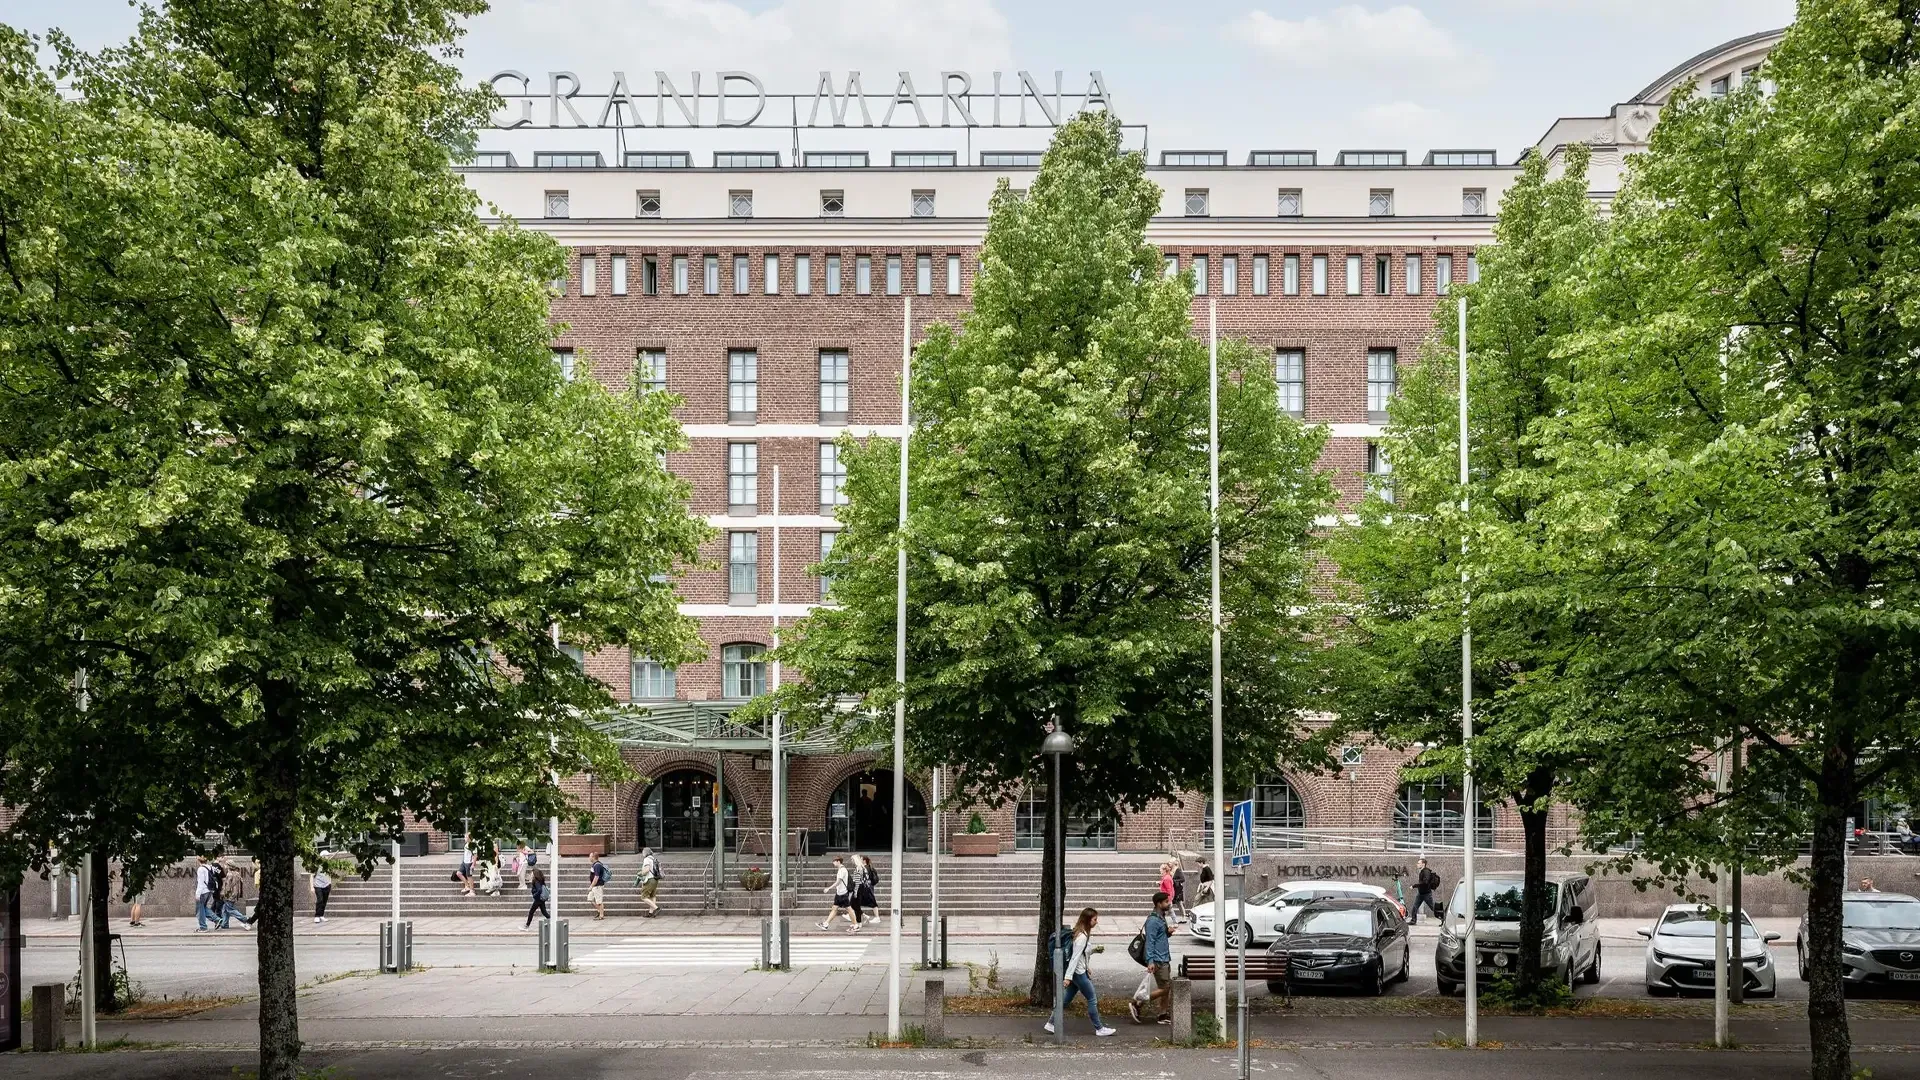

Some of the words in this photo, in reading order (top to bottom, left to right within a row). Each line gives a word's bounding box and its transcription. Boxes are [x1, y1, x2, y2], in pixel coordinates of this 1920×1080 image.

[488, 69, 766, 131] GRAND
[807, 70, 1117, 128] MARINA
[167, 867, 198, 879] GRAN
[1276, 865, 1315, 877] HOTEL
[1315, 865, 1360, 877] GRAND
[1361, 865, 1410, 877] MARINA
